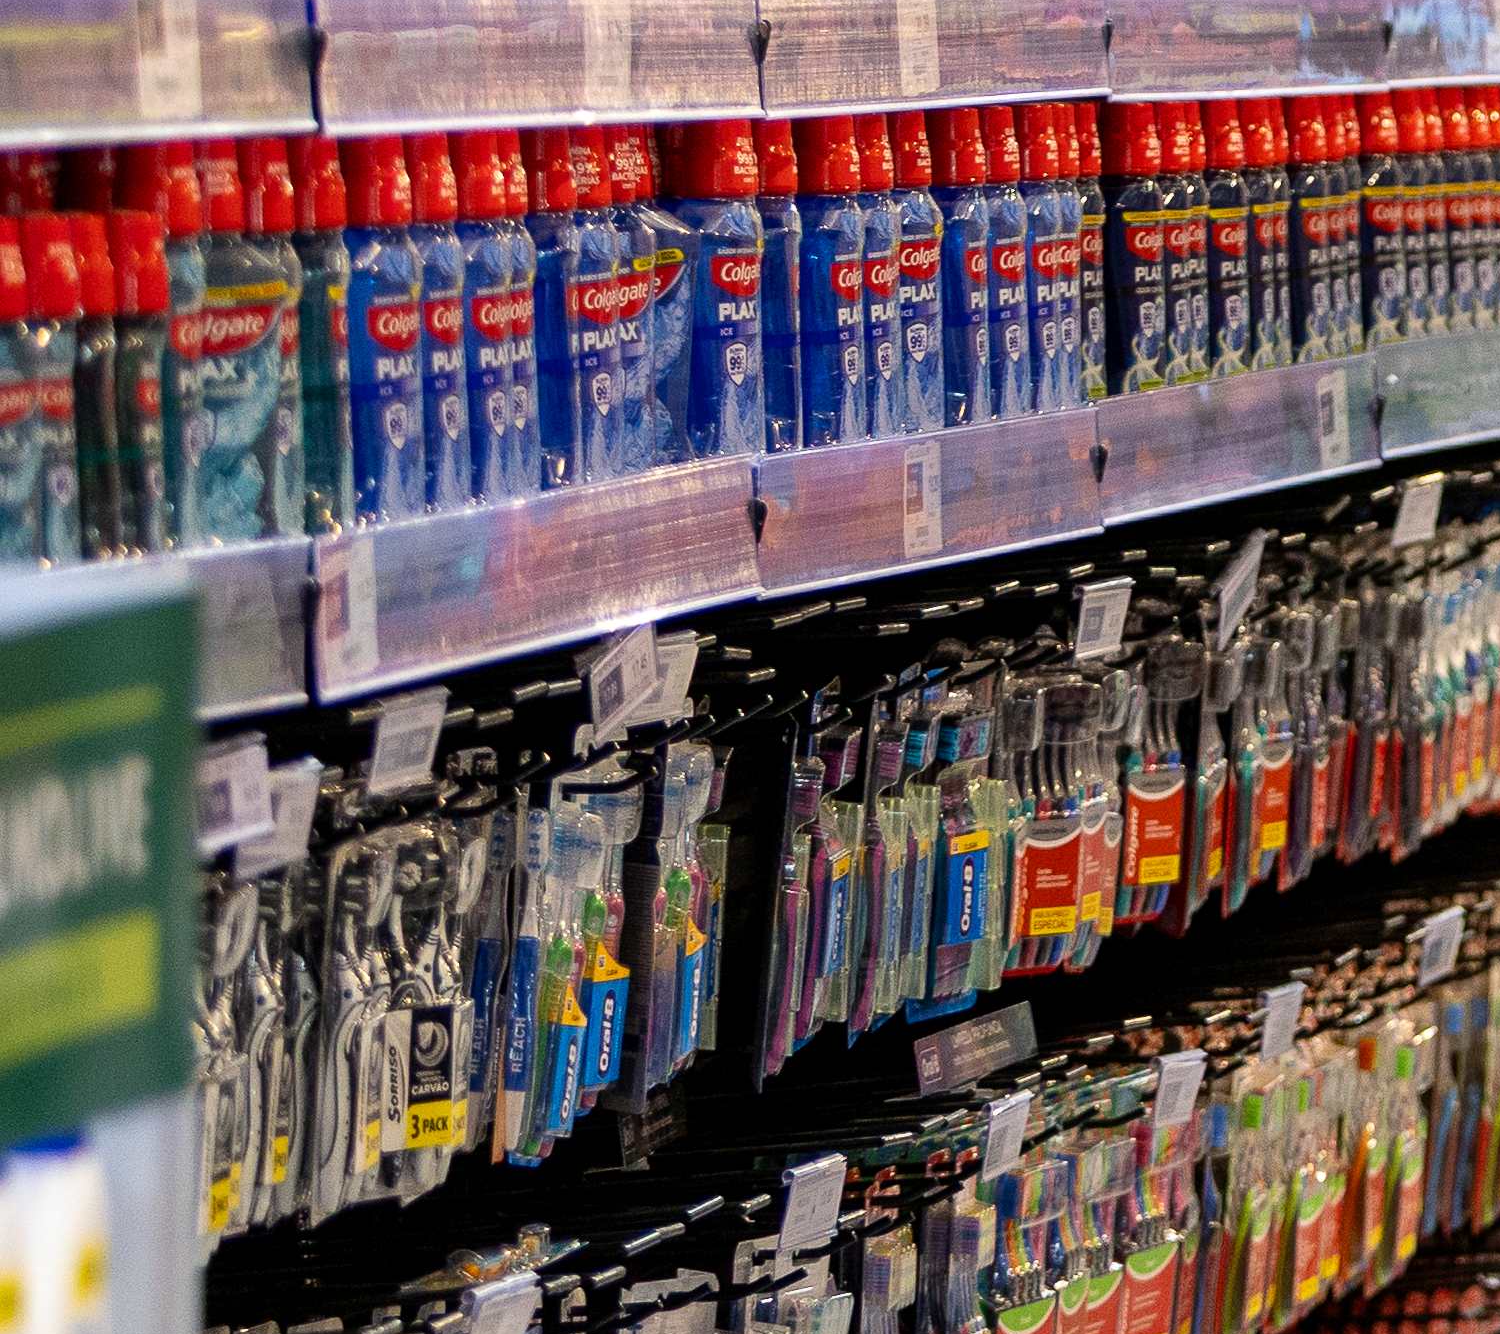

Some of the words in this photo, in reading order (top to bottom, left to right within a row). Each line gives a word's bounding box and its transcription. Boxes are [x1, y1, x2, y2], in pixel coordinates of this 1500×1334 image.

[719, 300, 756, 321] PLAX
[900, 282, 936, 303] PLAX
[961, 863, 973, 933] Oral-B
[510, 1016, 527, 1074] REACH
[599, 996, 616, 1072] Oral-B
[388, 1046, 400, 1124] SORRISO
[411, 1080, 450, 1096] CARVÃO
[411, 1114, 420, 1138] 3
[422, 1116, 449, 1133] PACK
